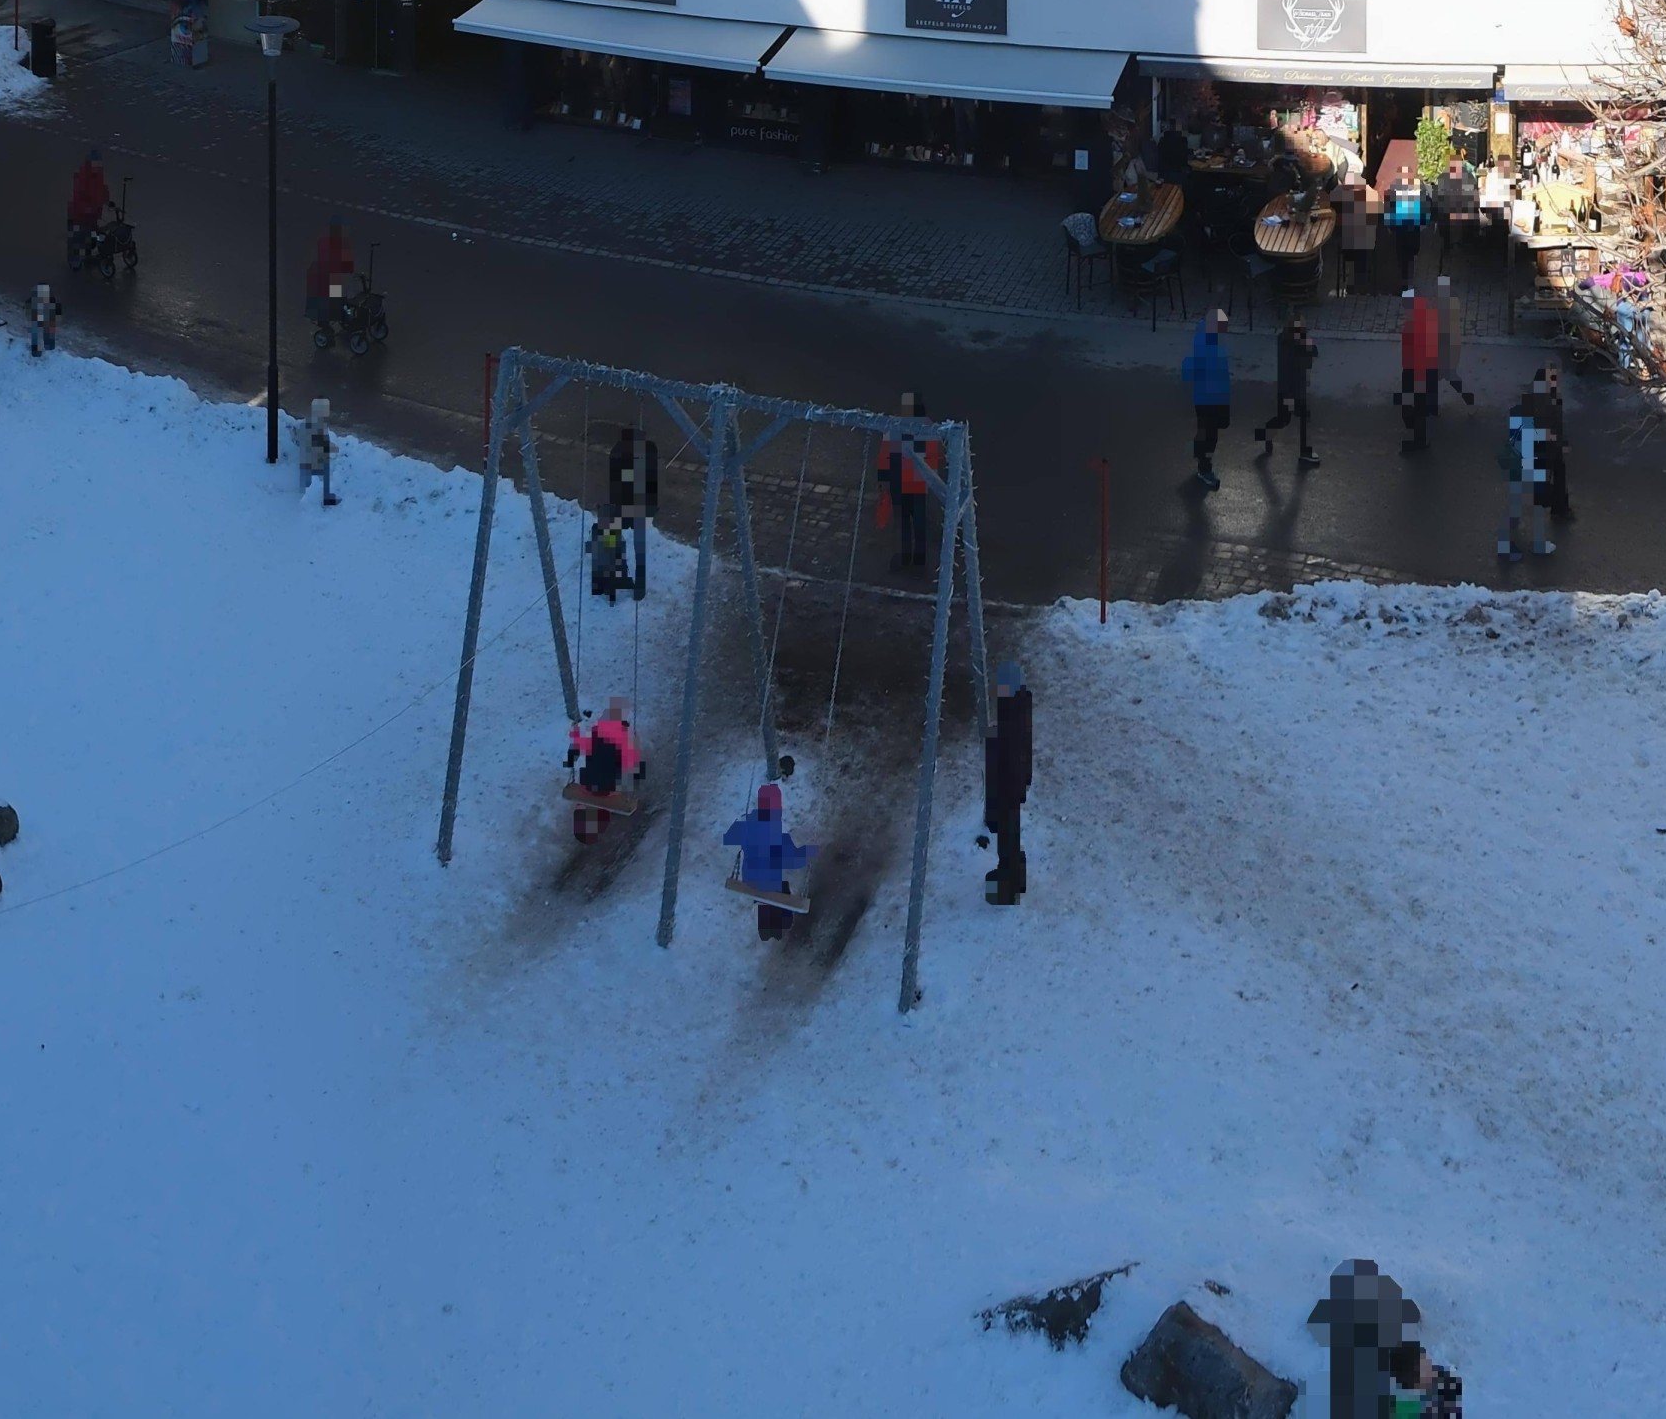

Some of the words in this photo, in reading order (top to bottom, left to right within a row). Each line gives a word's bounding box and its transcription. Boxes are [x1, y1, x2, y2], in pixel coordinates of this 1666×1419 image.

[915, 19, 944, 27] SEEFELD
[946, 22, 982, 30] SHOPPING
[730, 126, 756, 138] pure
